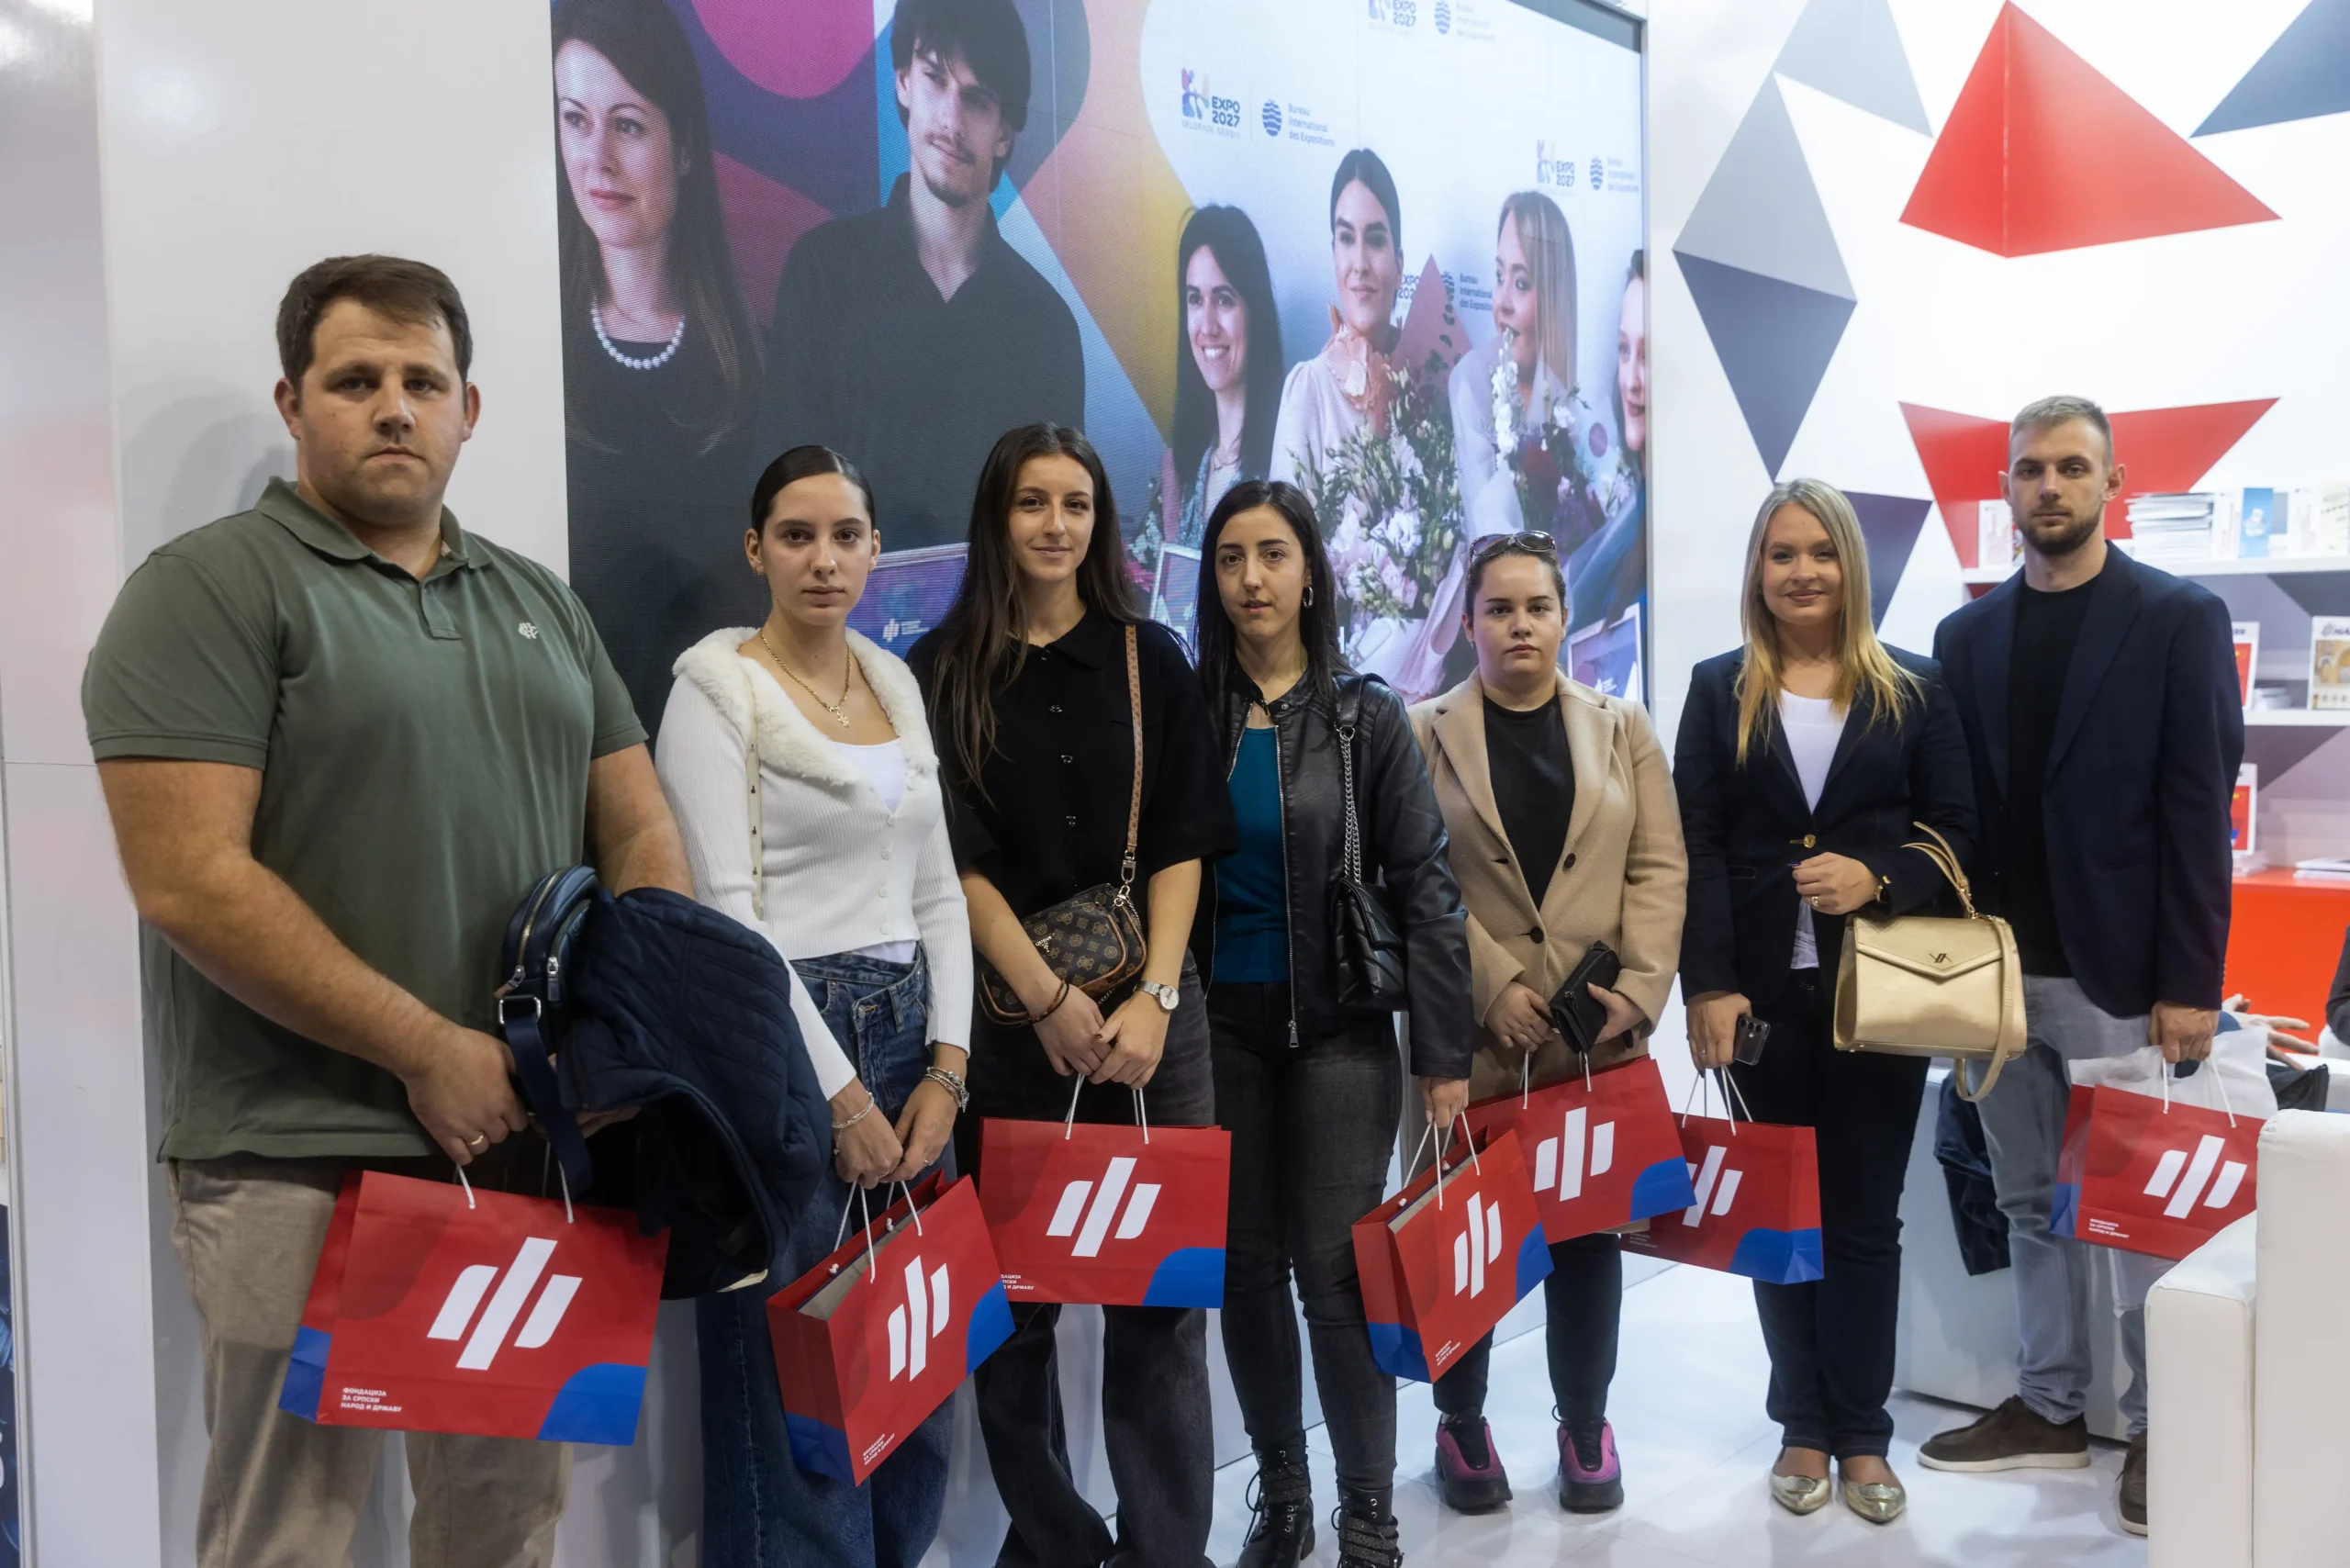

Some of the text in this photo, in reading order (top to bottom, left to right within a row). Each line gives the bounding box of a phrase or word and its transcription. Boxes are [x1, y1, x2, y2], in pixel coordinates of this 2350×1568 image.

[1393, 12, 1416, 27] 2027
[1212, 95, 1240, 114] EXPO
[1212, 110, 1240, 128] 2027
[342, 1387, 387, 1397] ФОНДАЦИЈА
[352, 1395, 381, 1404] СРПСКИ
[341, 1402, 365, 1410] НАРОД
[372, 1405, 402, 1413] ДРЖАВУ
